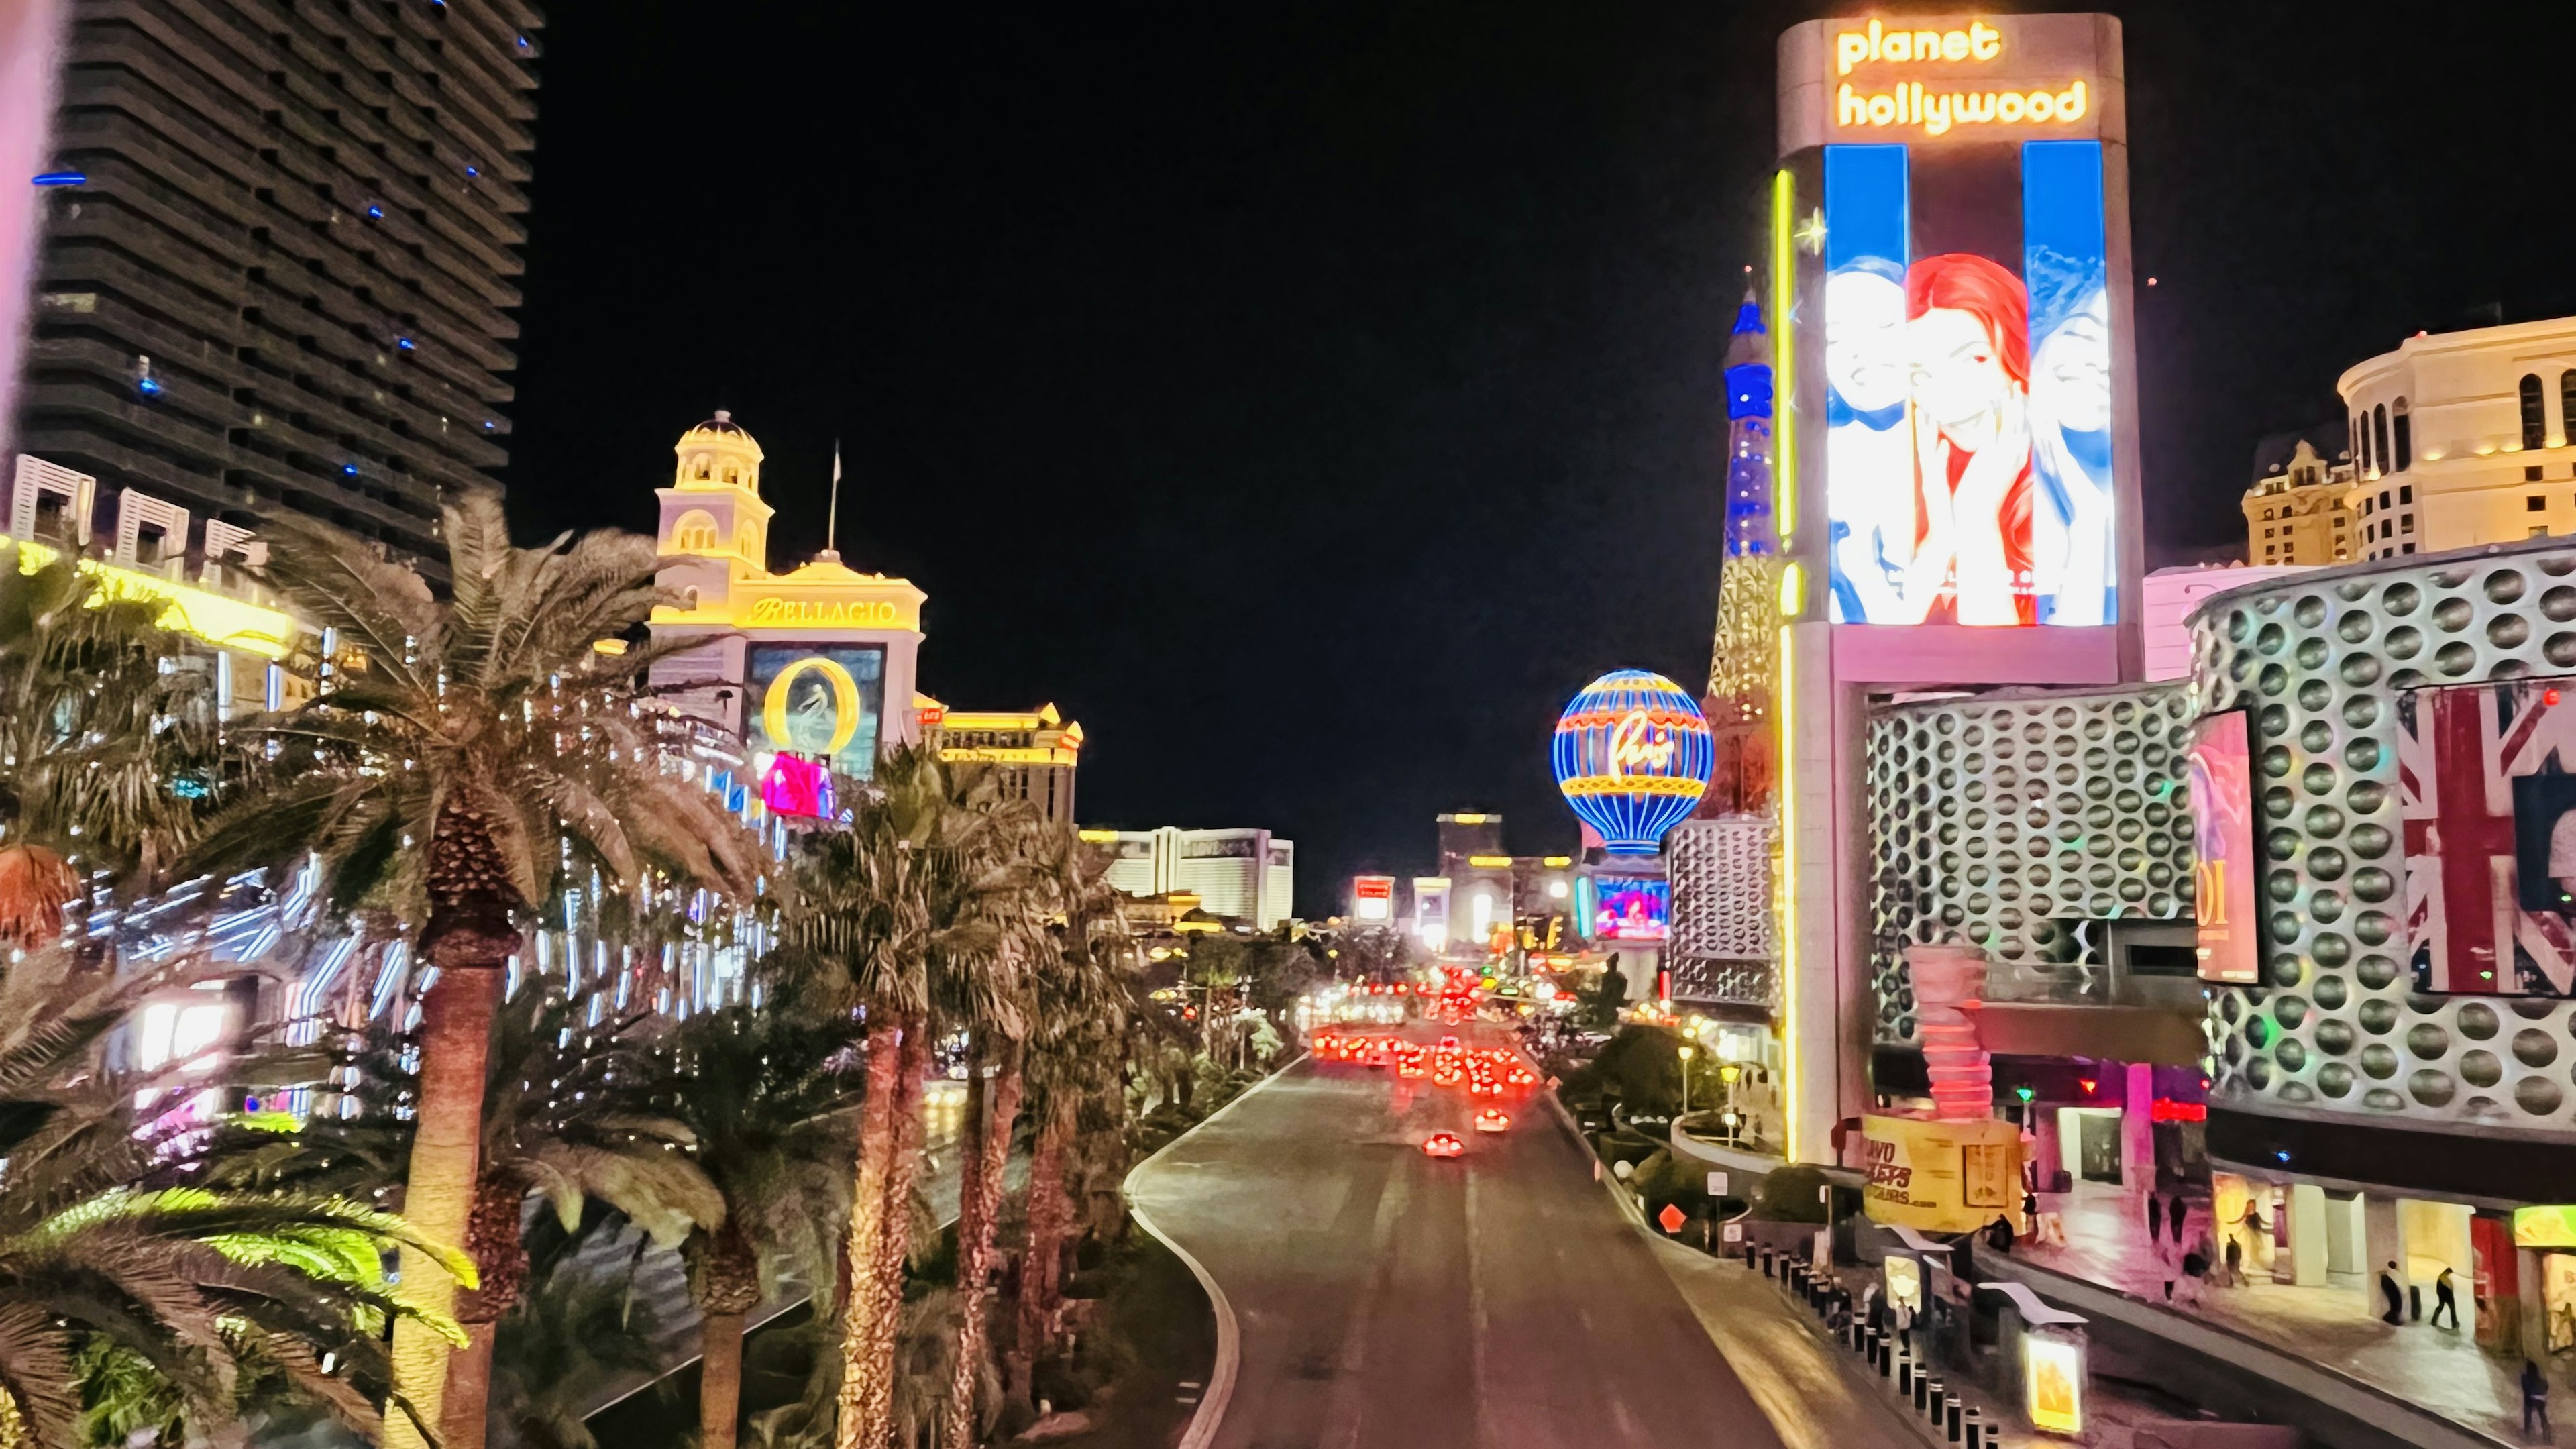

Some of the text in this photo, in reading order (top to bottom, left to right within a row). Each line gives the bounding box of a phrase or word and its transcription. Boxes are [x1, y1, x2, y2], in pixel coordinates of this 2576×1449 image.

[1837, 18, 2001, 76] planet
[1838, 80, 2087, 136] hollywood
[747, 597, 896, 623] BELLAGIO
